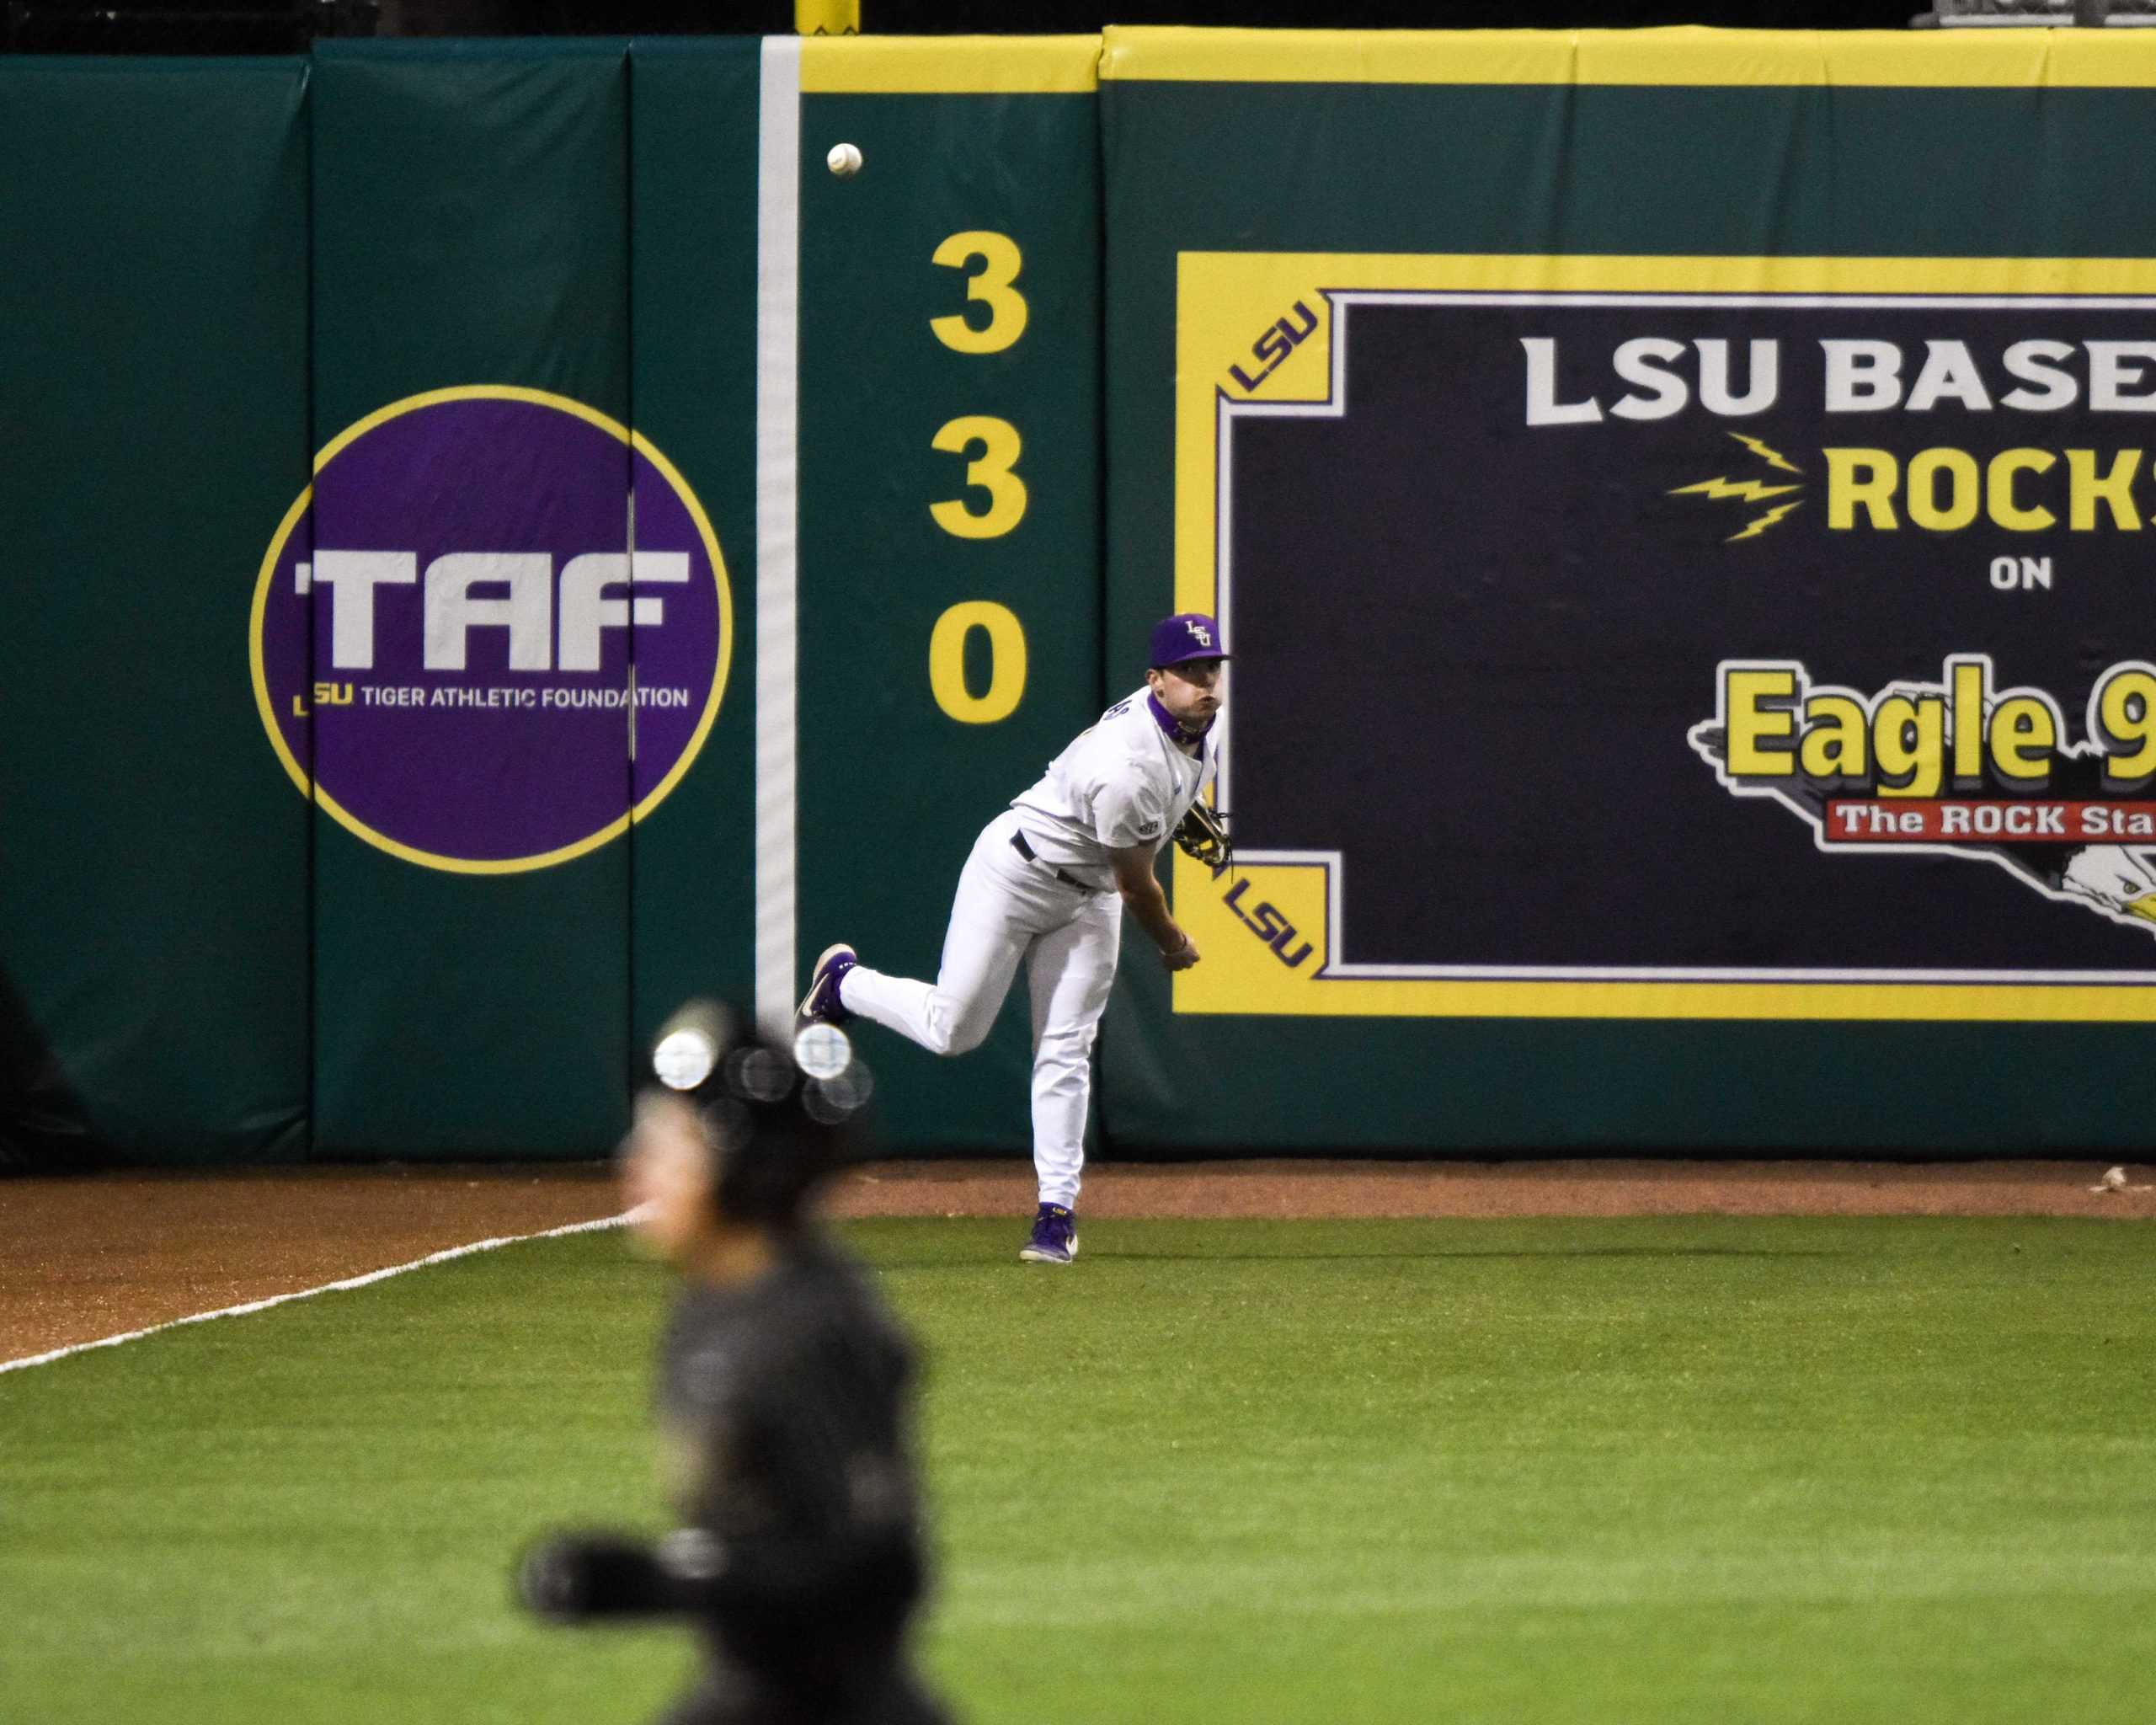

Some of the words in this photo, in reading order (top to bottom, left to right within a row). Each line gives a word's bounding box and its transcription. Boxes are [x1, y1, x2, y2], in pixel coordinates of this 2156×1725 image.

[1228, 301, 1319, 393] LSU
[1519, 338, 1778, 425] LSU
[1818, 339, 2156, 414] BASE
[1822, 447, 2156, 532] ROCK
[295, 549, 690, 671] TAF
[1990, 557, 2052, 590] ON
[1185, 620, 1211, 647] LSU
[293, 682, 354, 717] LSU
[360, 686, 424, 707] TIGER
[430, 686, 536, 708] ATHLETIC
[542, 687, 688, 708] FOUNDATION
[1725, 664, 2057, 798] Eagle
[2101, 672, 2156, 778] 9
[1835, 804, 1924, 834] The
[1940, 804, 2065, 835] ROCK
[2080, 805, 2154, 836] Sta
[1223, 878, 1314, 969] LSU
